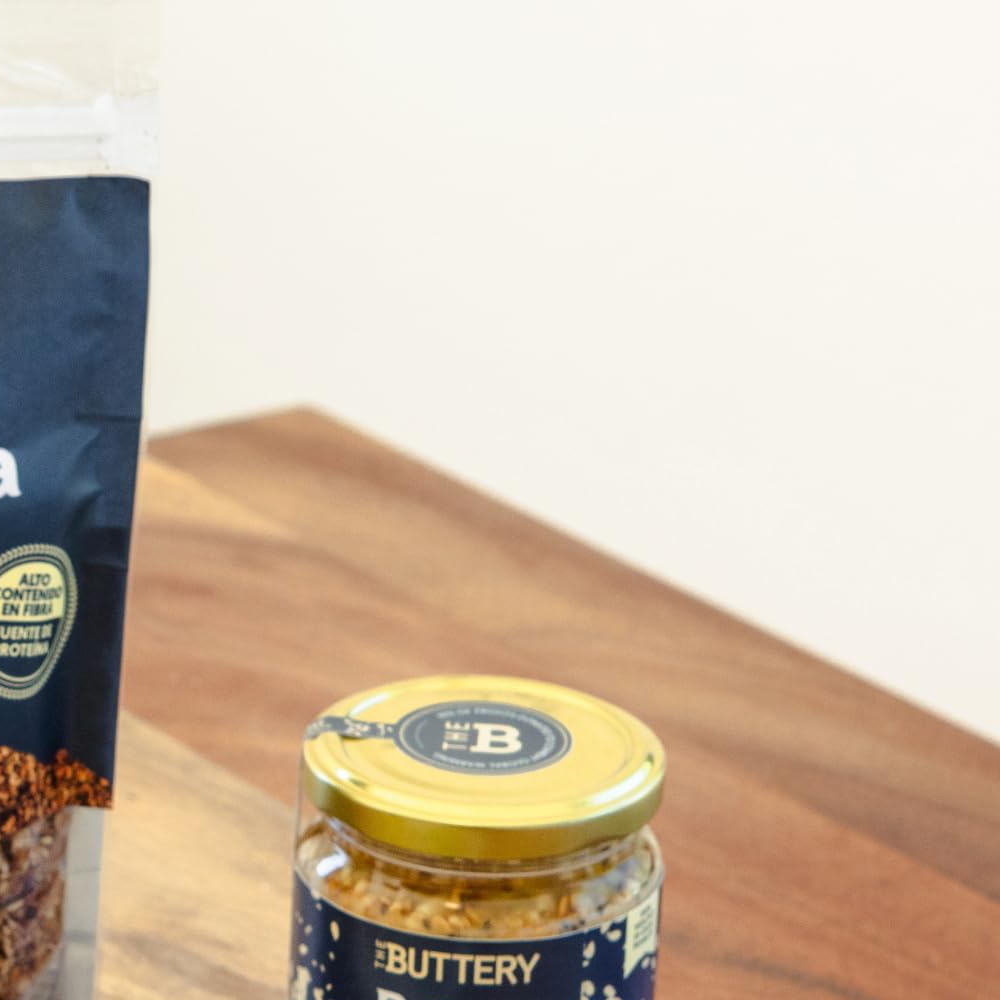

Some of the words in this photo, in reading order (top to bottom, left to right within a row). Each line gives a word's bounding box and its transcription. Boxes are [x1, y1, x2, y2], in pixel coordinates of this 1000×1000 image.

[19, 573, 52, 586] ALTO
[1, 603, 19, 616] EN
[441, 720, 470, 752] THE
[470, 722, 522, 754] B
[384, 941, 541, 986] BUTTERY
